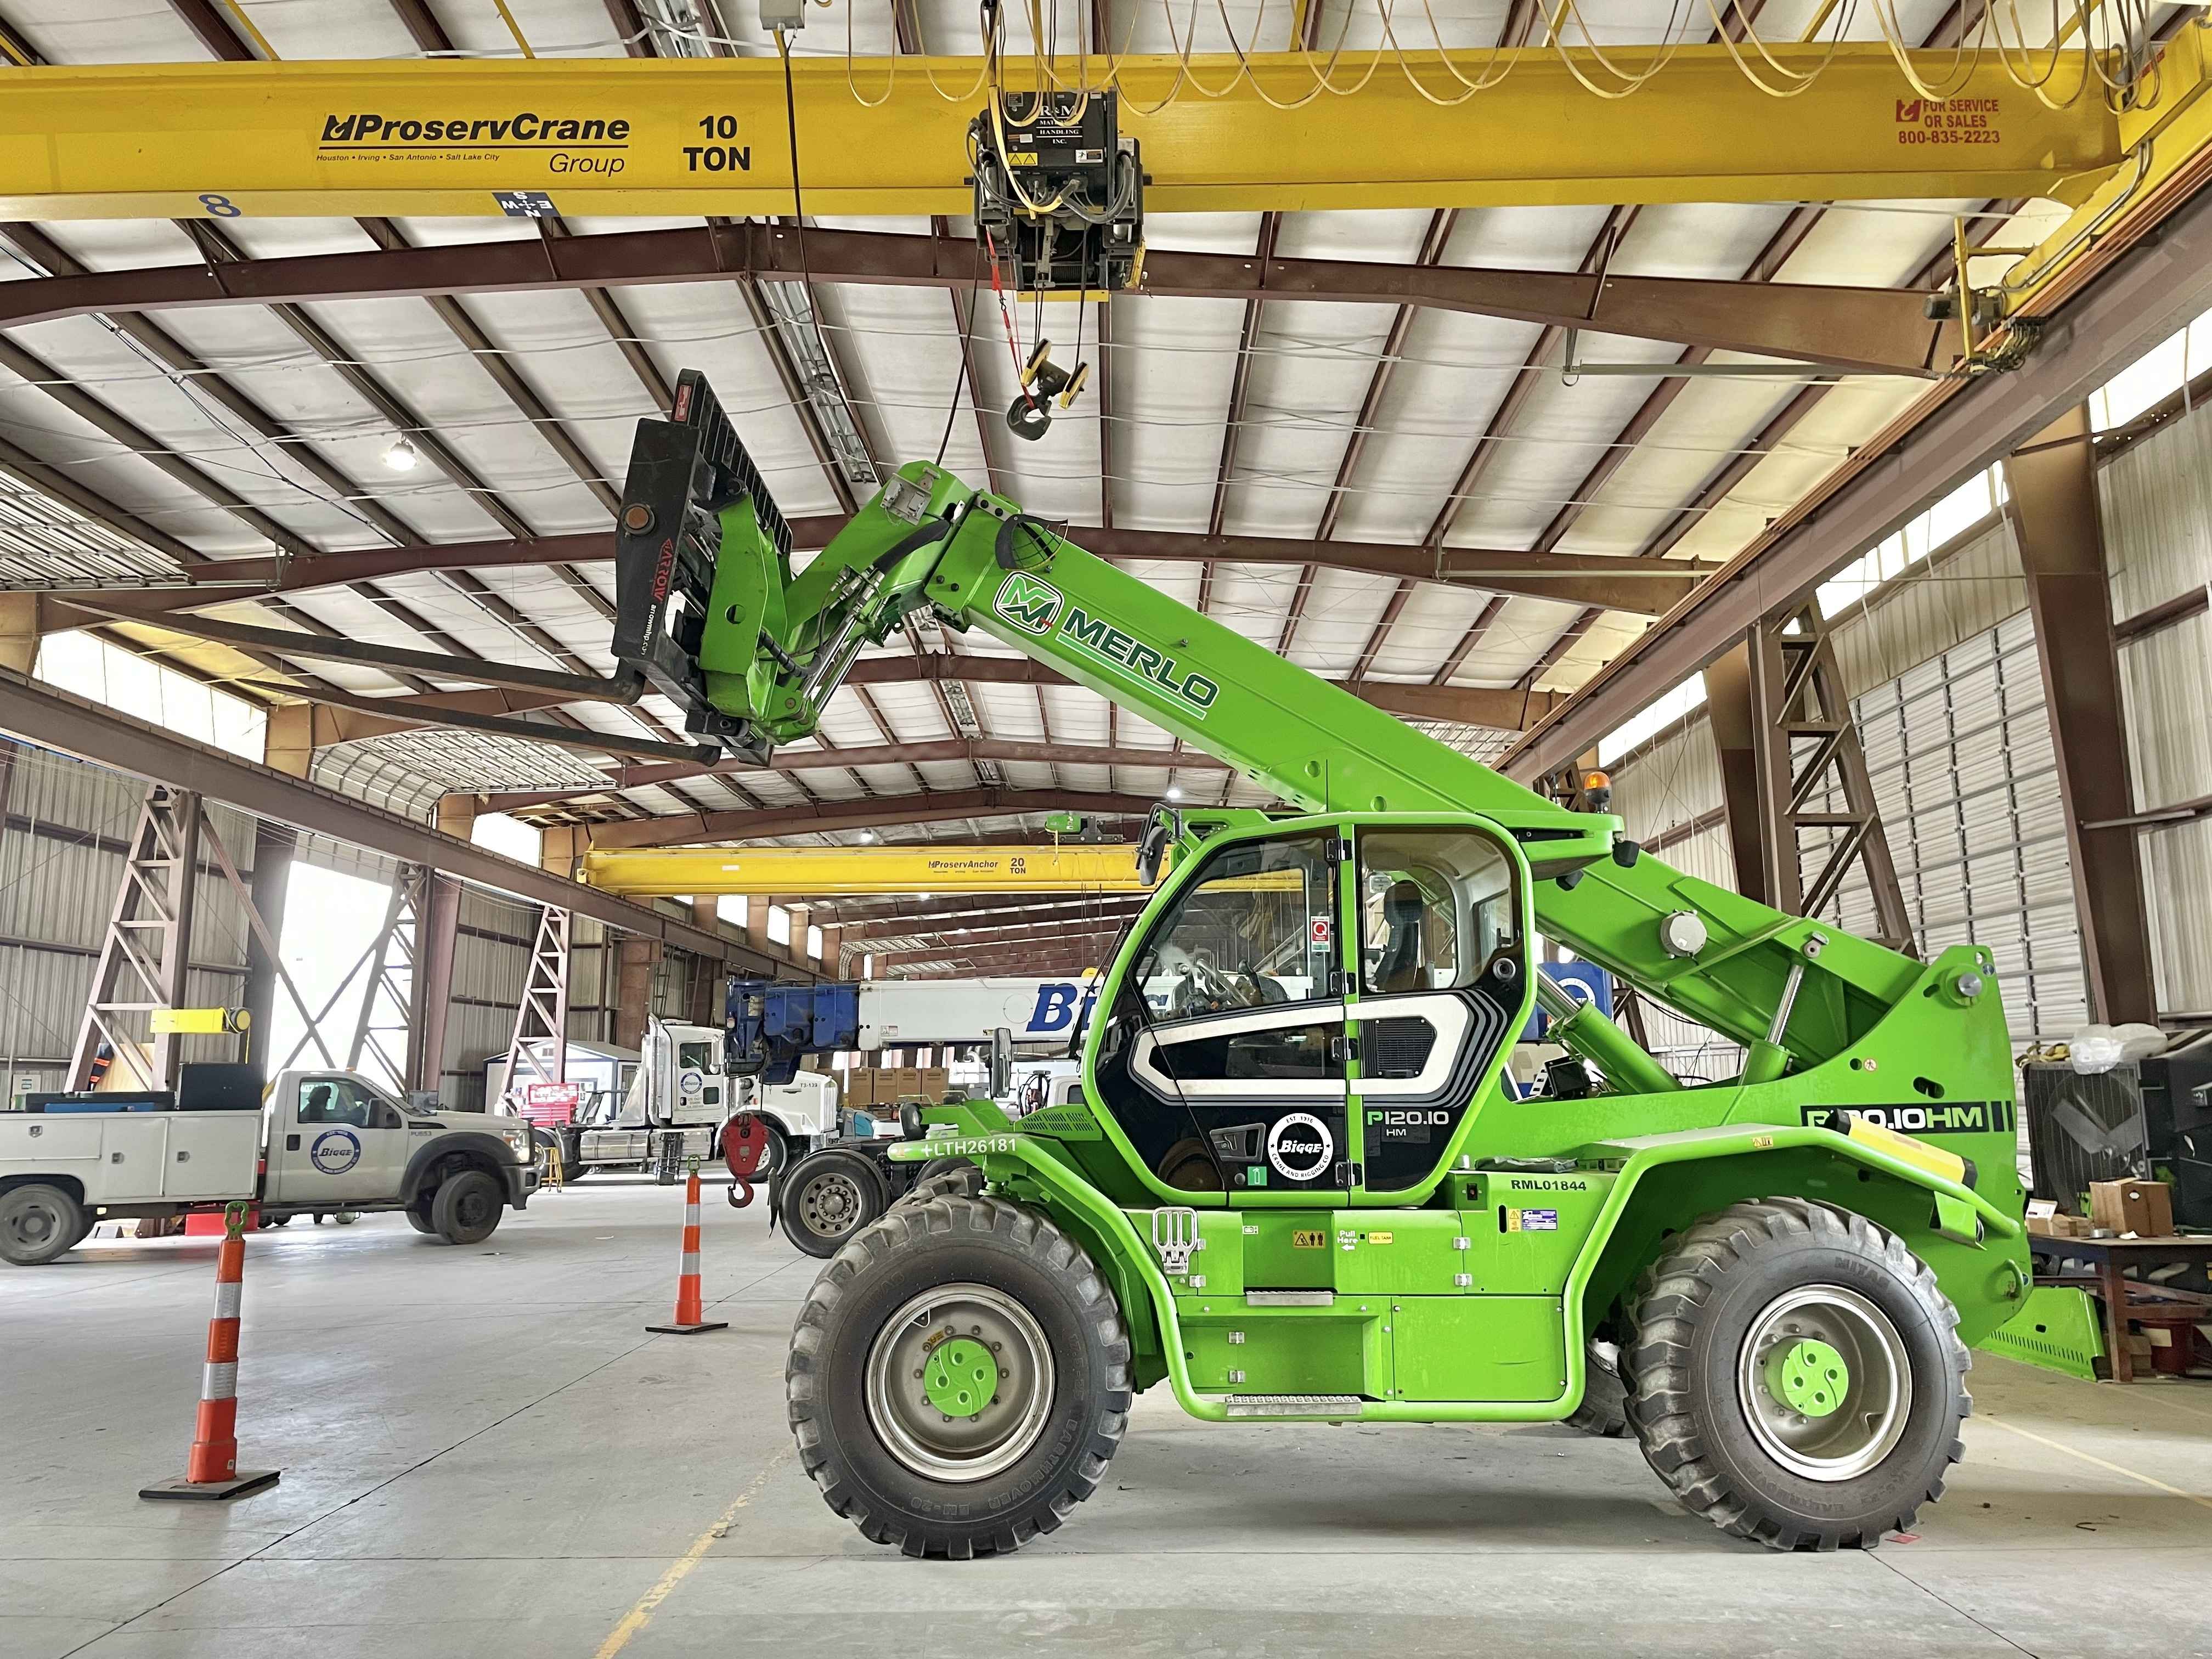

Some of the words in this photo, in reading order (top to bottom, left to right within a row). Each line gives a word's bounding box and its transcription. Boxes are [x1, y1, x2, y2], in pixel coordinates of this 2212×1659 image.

[1923, 99, 1946, 112] FOR
[1949, 99, 1999, 112] SERVICE
[353, 112, 630, 141] ProservCrane
[698, 115, 738, 139] 10
[1925, 115, 1942, 127] OR
[1946, 115, 1987, 127] SALES
[1898, 131, 2000, 144] 800-835-2223
[484, 153, 500, 162] City
[549, 153, 625, 177] Group
[682, 146, 751, 172] TON
[198, 194, 241, 218] 8
[653, 552, 673, 602] ARROW
[1063, 606, 1219, 708] MERLO
[1011, 857, 1025, 867] 20
[1367, 1111, 1449, 1125] P120.10
[1386, 1128, 1407, 1137] HM
[1272, 1153, 1285, 1171] CRANE
[1301, 1164, 1324, 1177] RIGGING
[1511, 1180, 1587, 1191] RML01844
[988, 1418, 1078, 1509] EARTHMOVER
[911, 1497, 970, 1516] EM-20
